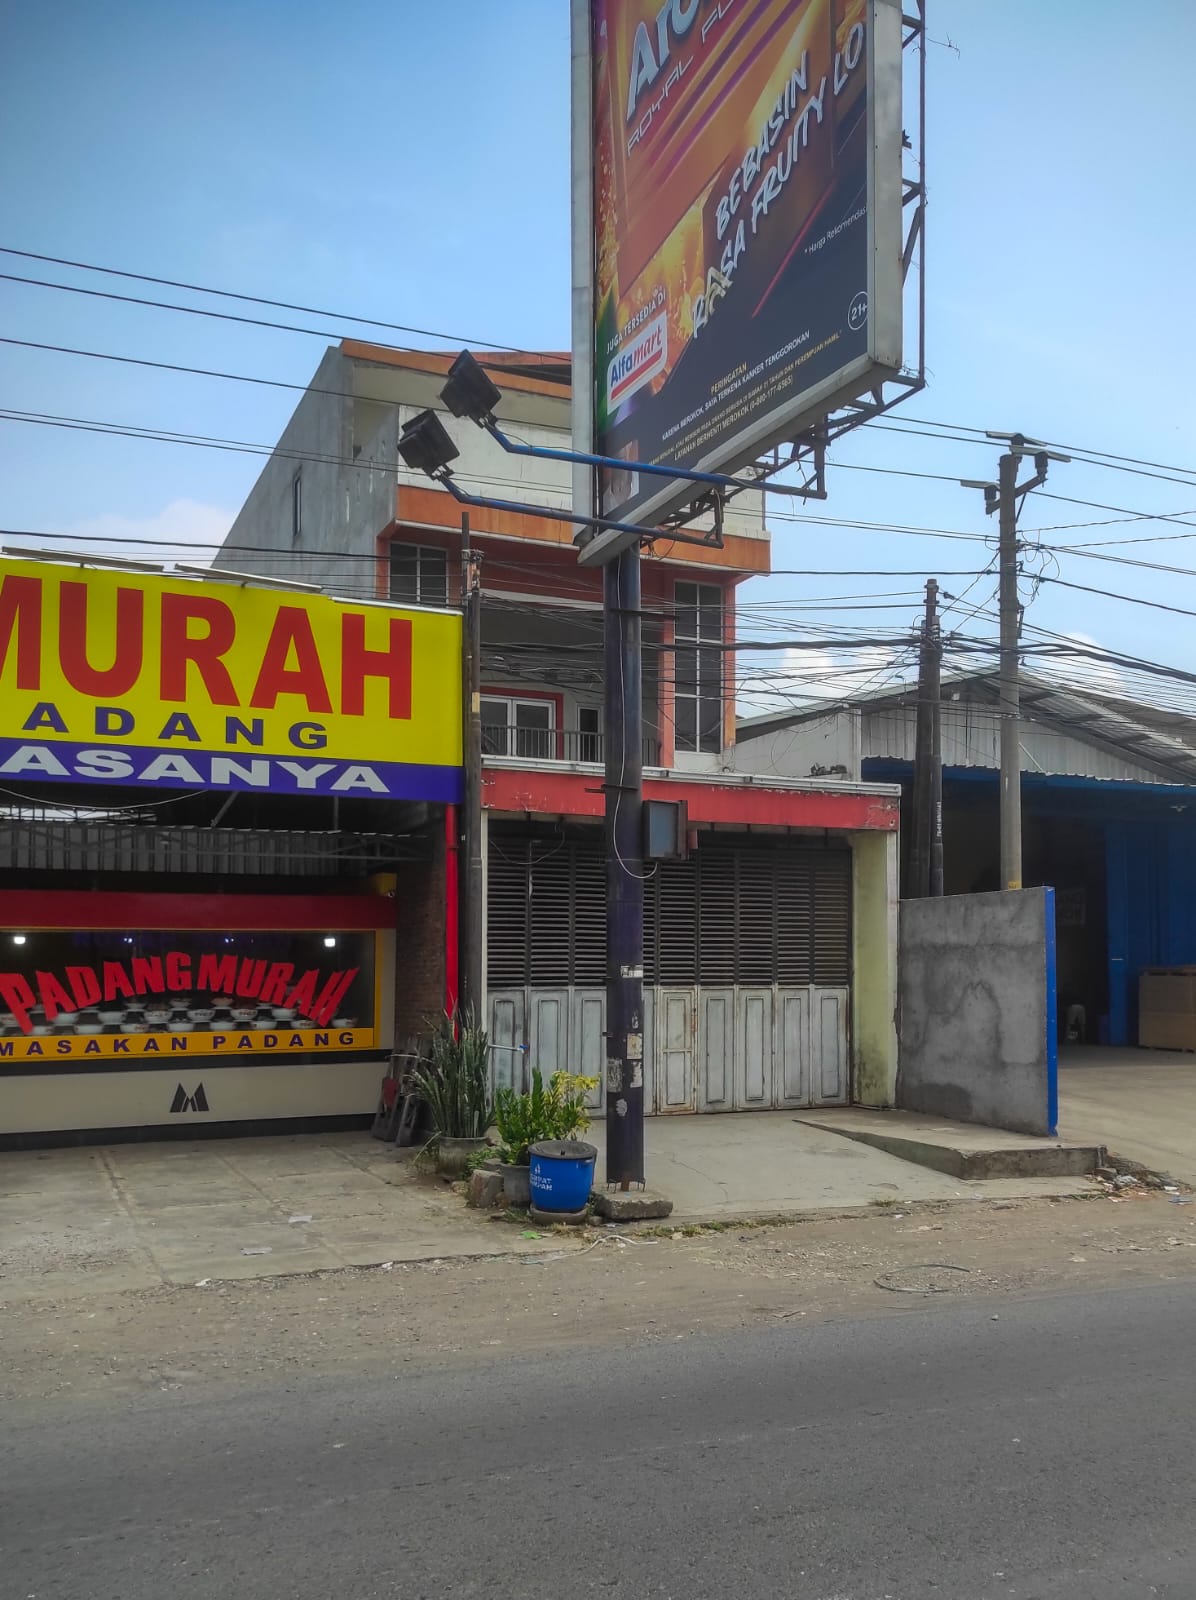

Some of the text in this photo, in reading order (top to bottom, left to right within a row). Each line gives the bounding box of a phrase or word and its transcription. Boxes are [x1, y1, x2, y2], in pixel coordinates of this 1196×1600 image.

[627, 55, 694, 157] ROYAL
[715, 49, 808, 241] BEBASIN
[692, 218, 747, 339] RASA
[752, 75, 827, 234] FRUITY
[606, 288, 666, 355] JUGA TERSEDIA DI
[851, 302, 868, 321] 21+
[610, 323, 662, 388] Alfamart
[704, 394, 716, 411] SAYA
[718, 377, 741, 401] TERKENA
[742, 361, 763, 384] KANKER
[765, 328, 809, 368] TENGGOROKAN
[710, 360, 746, 396] PERINGATAN
[696, 422, 721, 446] BERHENTI
[722, 403, 748, 429] MEROKOK
[22, 702, 328, 749] ADANG
[0, 745, 391, 793] ASANYA
[0, 951, 361, 1035] PADANG MURAH
[0, 1031, 354, 1057] MASAKAN PADANG
